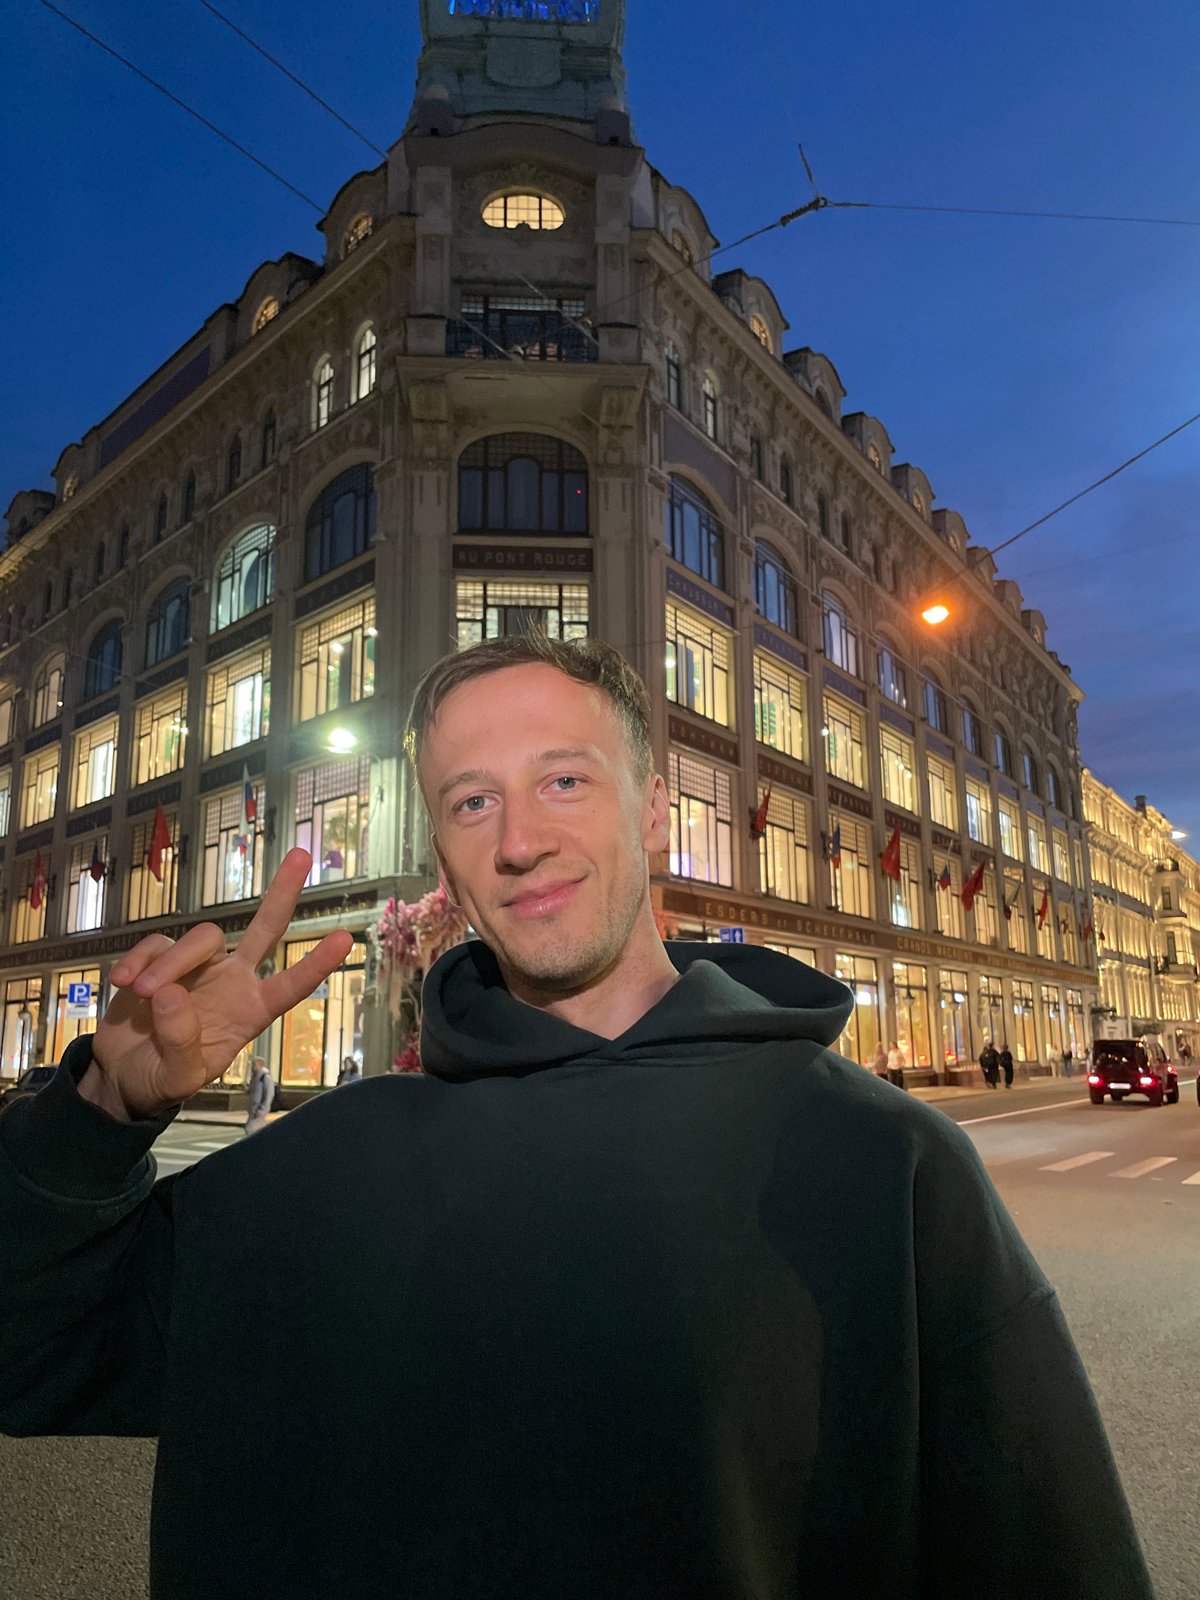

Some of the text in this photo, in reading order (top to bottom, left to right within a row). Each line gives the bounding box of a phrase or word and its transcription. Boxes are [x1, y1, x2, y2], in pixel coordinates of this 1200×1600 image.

[458, 550, 588, 566] AU PONT ROUGE
[705, 902, 769, 925] ESDERS
[74, 984, 88, 1002] P
